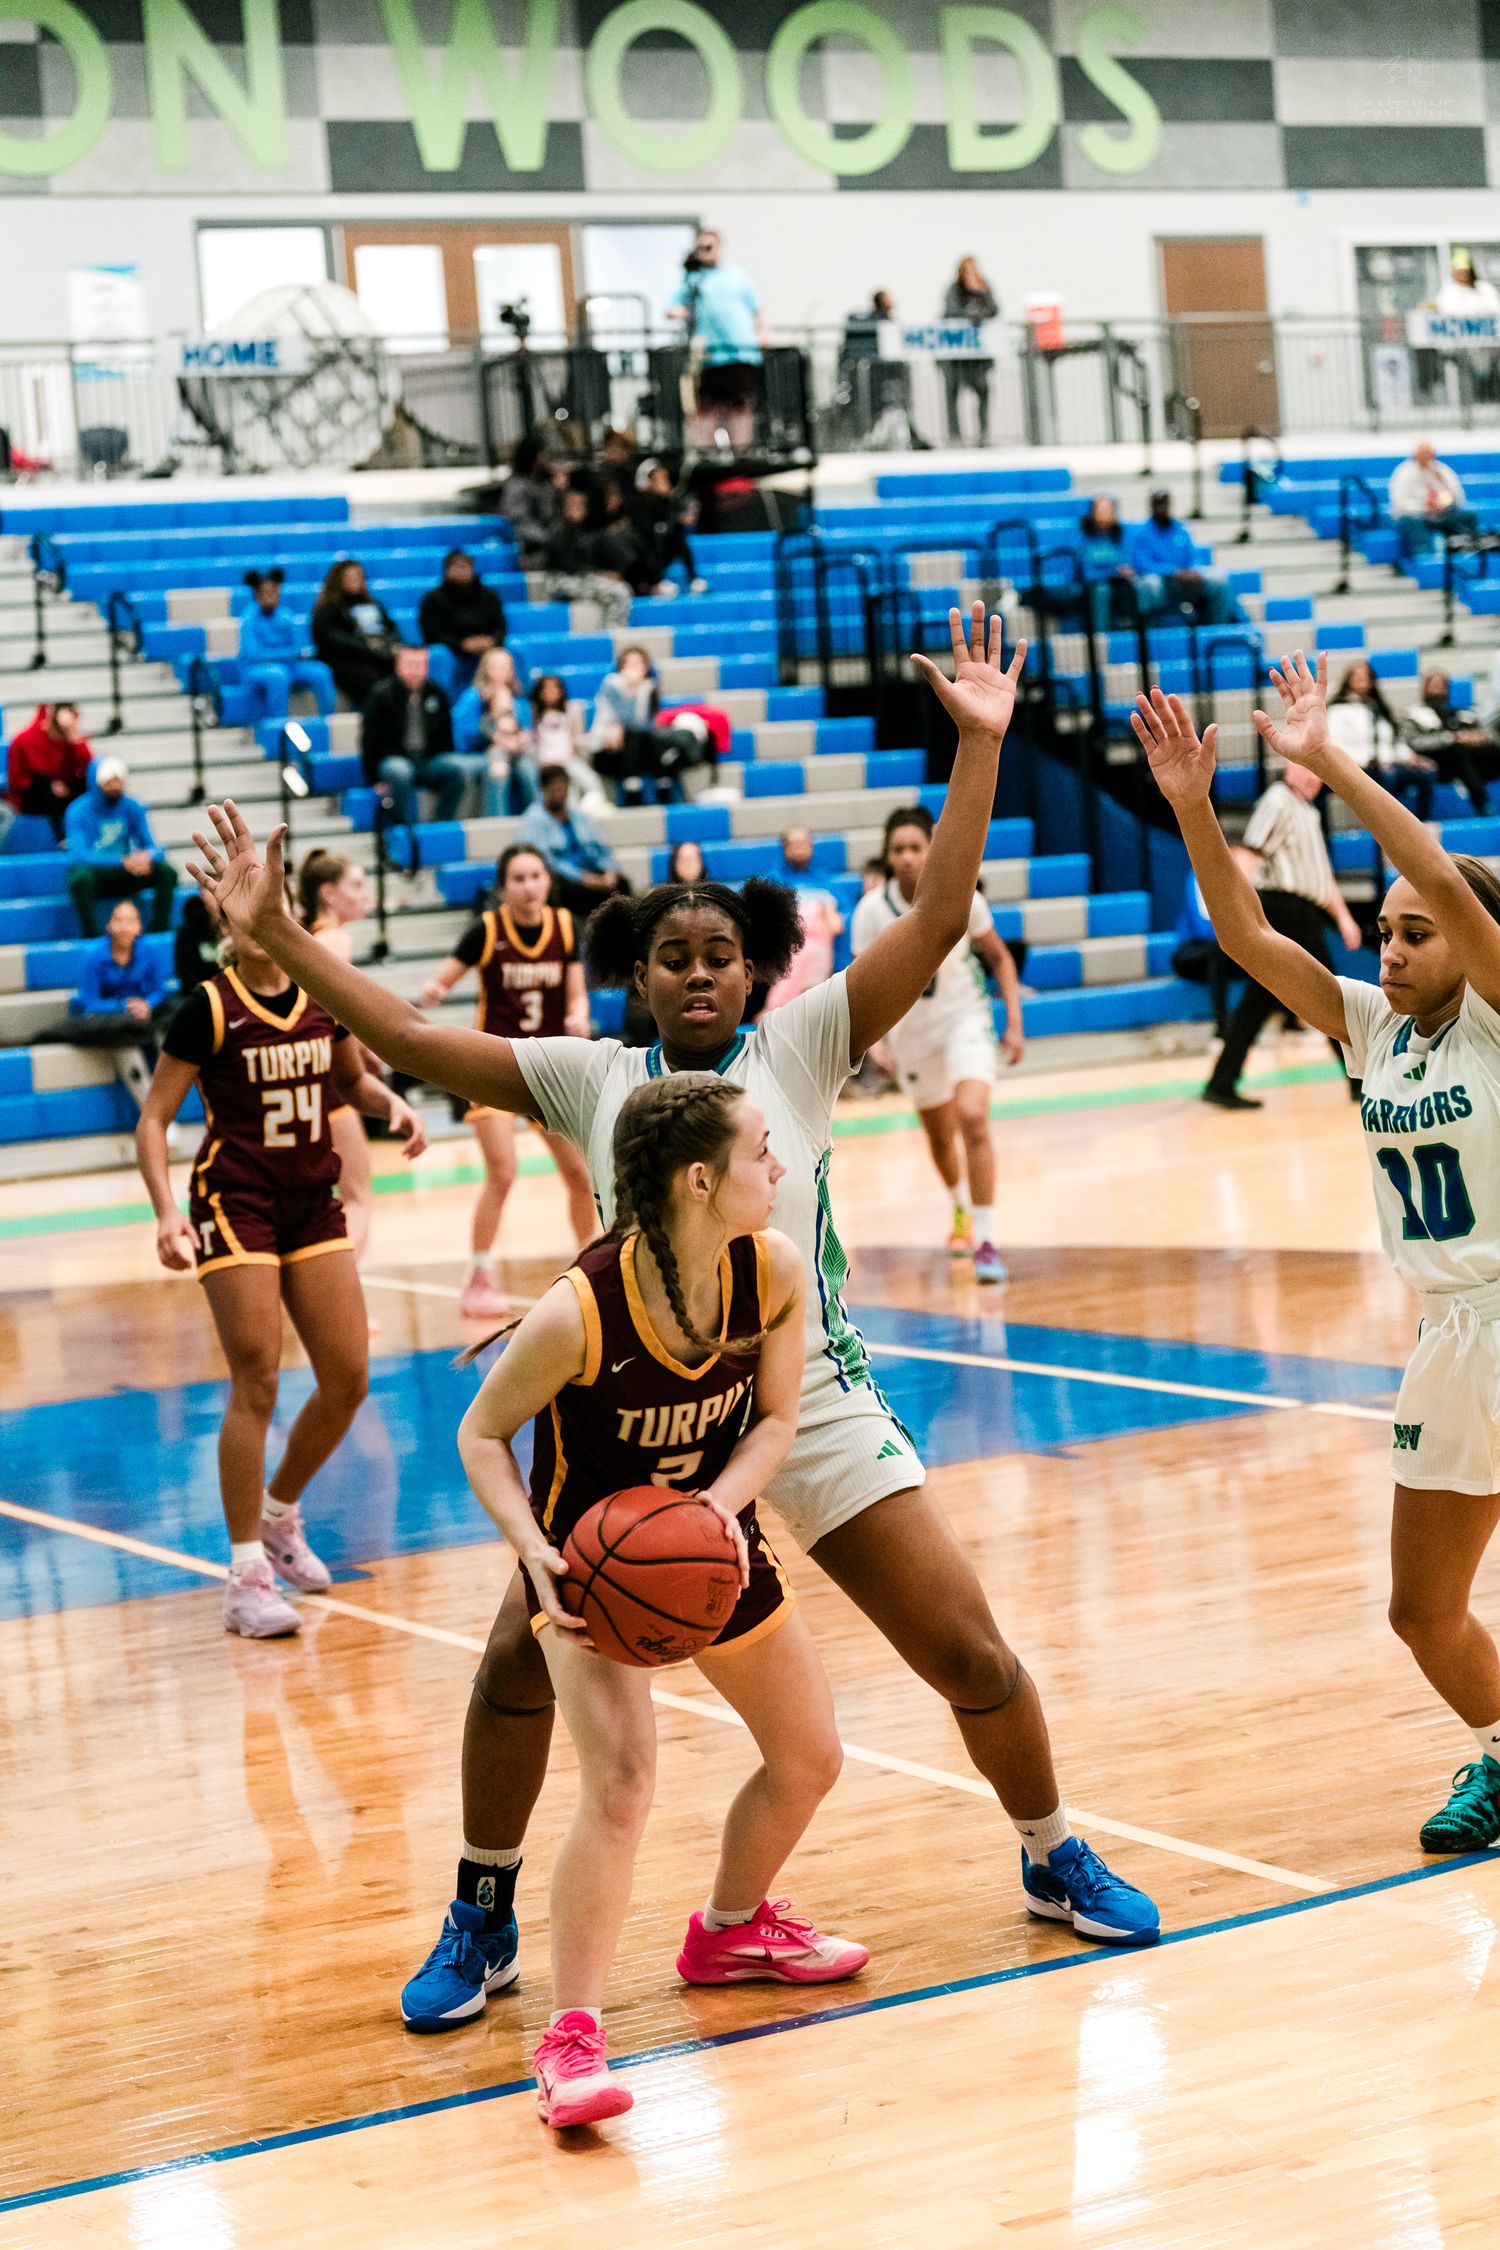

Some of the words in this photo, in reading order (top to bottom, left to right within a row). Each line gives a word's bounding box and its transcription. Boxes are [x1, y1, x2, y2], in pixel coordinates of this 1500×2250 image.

[379, 0, 1162, 176] WOODS
[904, 326, 981, 349] HOME
[1429, 316, 1498, 338] HOME
[182, 339, 278, 367] HOME
[501, 961, 563, 990] TURPIN
[519, 989, 543, 1032] 3
[241, 1035, 333, 1083] TURPIN
[261, 1083, 322, 1147] 24
[1376, 1142, 1476, 1242] 10
[200, 1220, 216, 1256] T
